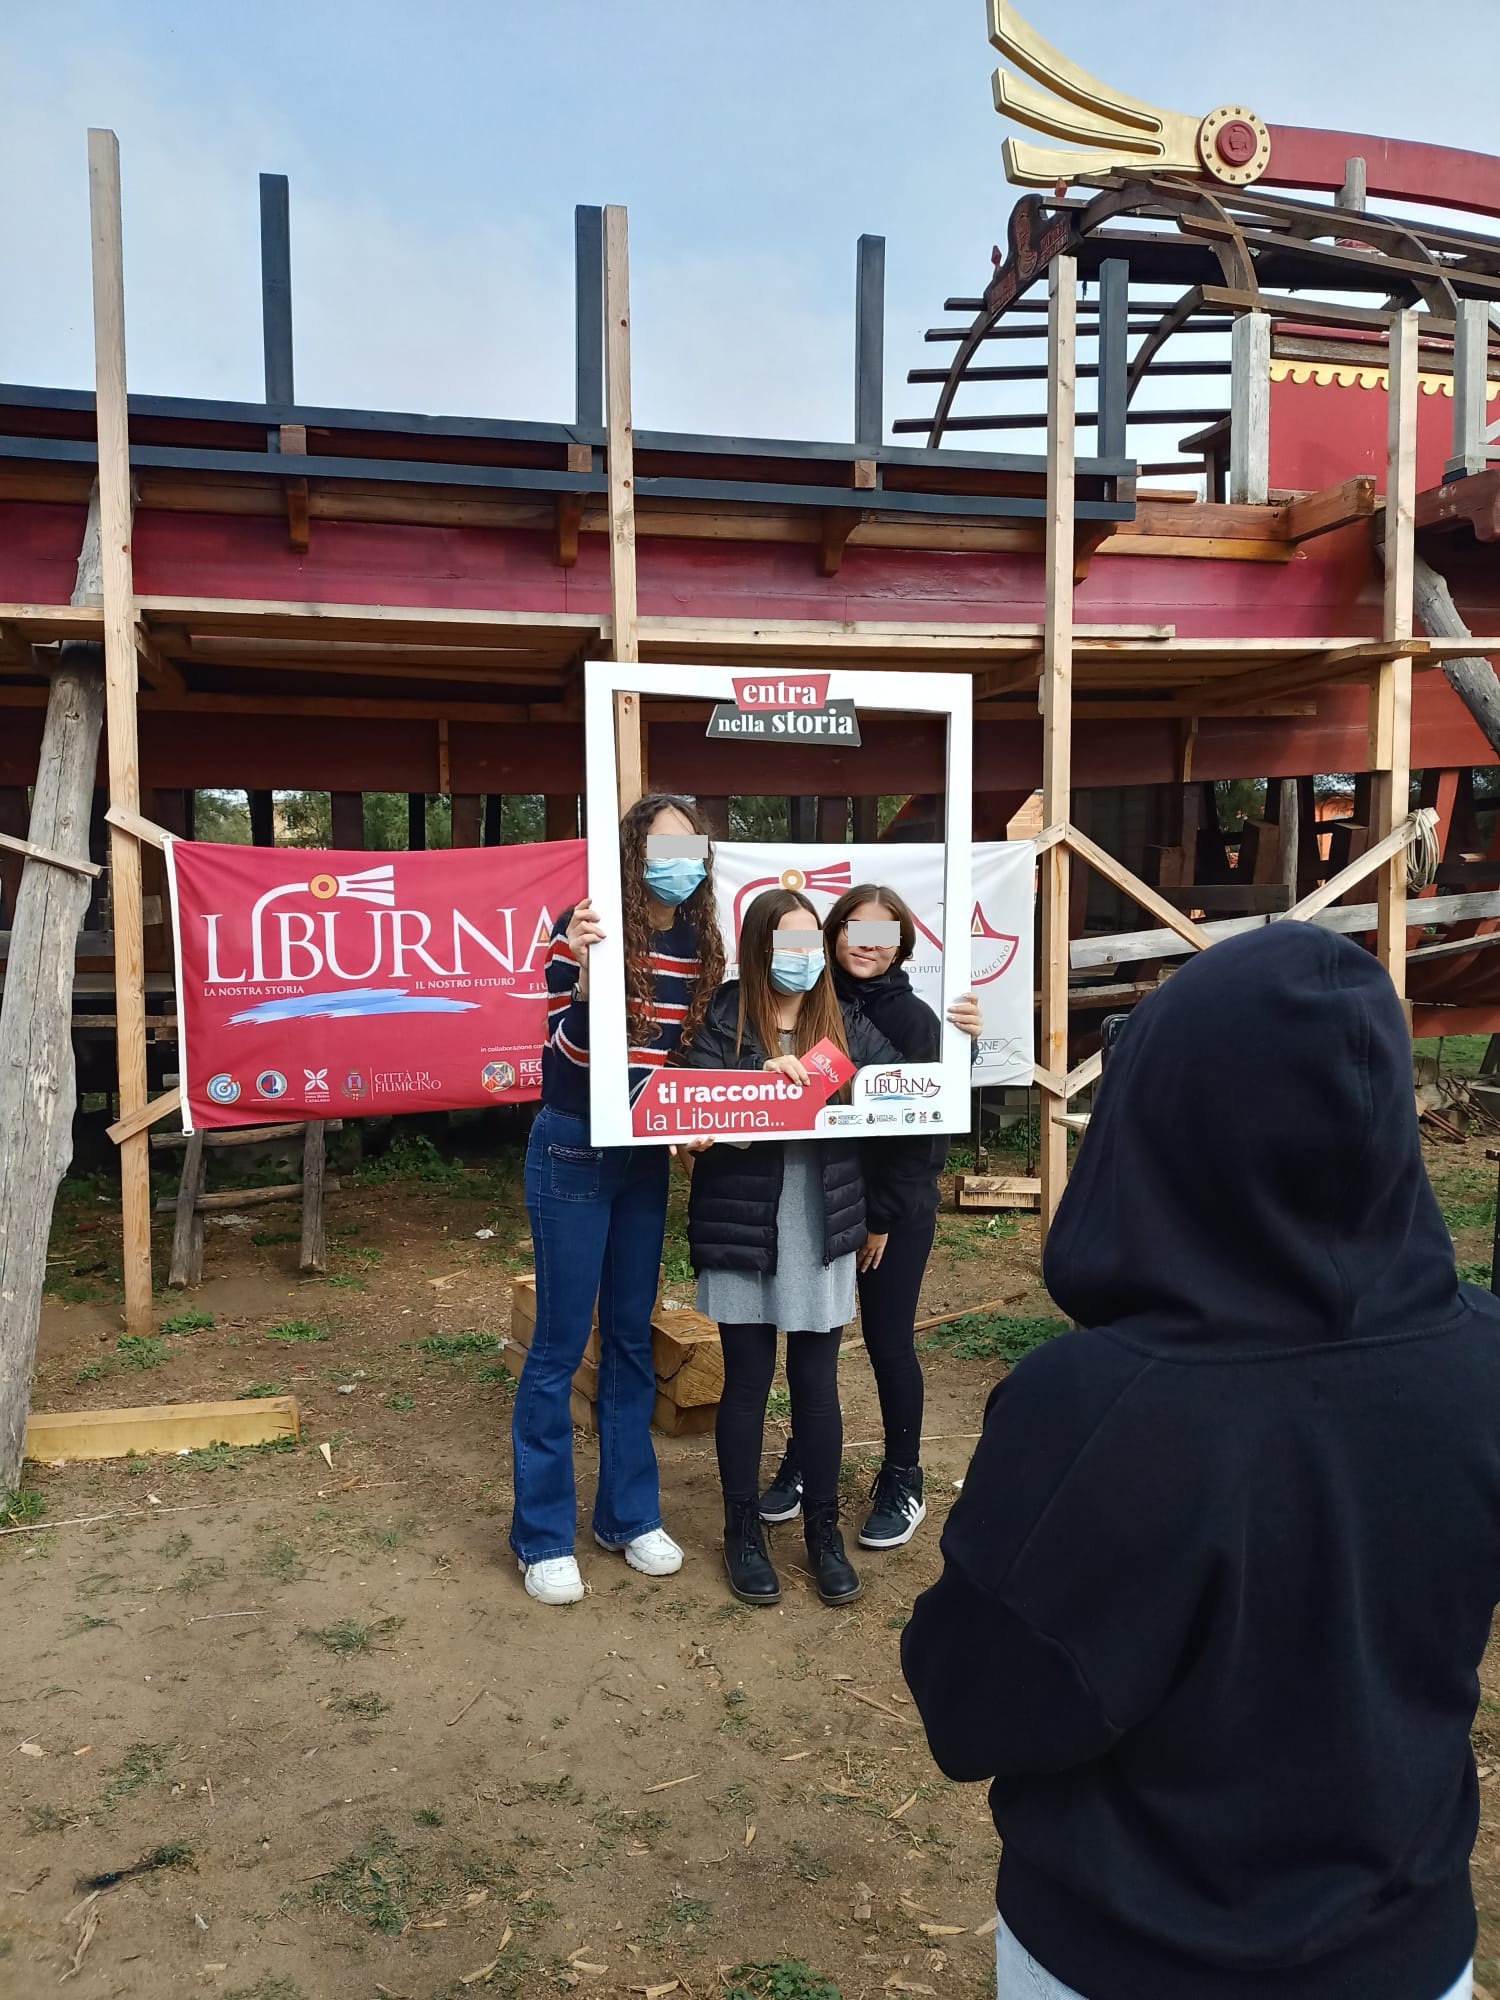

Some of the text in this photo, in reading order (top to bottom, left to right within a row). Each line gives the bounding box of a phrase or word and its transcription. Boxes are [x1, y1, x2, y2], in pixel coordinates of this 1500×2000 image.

[742, 681, 818, 705] entra
[718, 708, 853, 734] nella storia
[199, 888, 555, 984] LIBURNA
[919, 965, 941, 974] FUTU
[970, 944, 1010, 978] IUMICINO
[204, 985, 304, 997] LA NOSTRA STORIA
[415, 977, 516, 990] IL NOSTRO FUTURO
[375, 1069, 430, 1083] CITTÀ DI
[375, 1080, 442, 1092] FIUMICINO
[520, 1076, 543, 1087] LAZ
[864, 1075, 941, 1098] LIBURNA
[657, 1080, 803, 1104] ti racconto
[646, 1107, 785, 1131] la Liburna...
